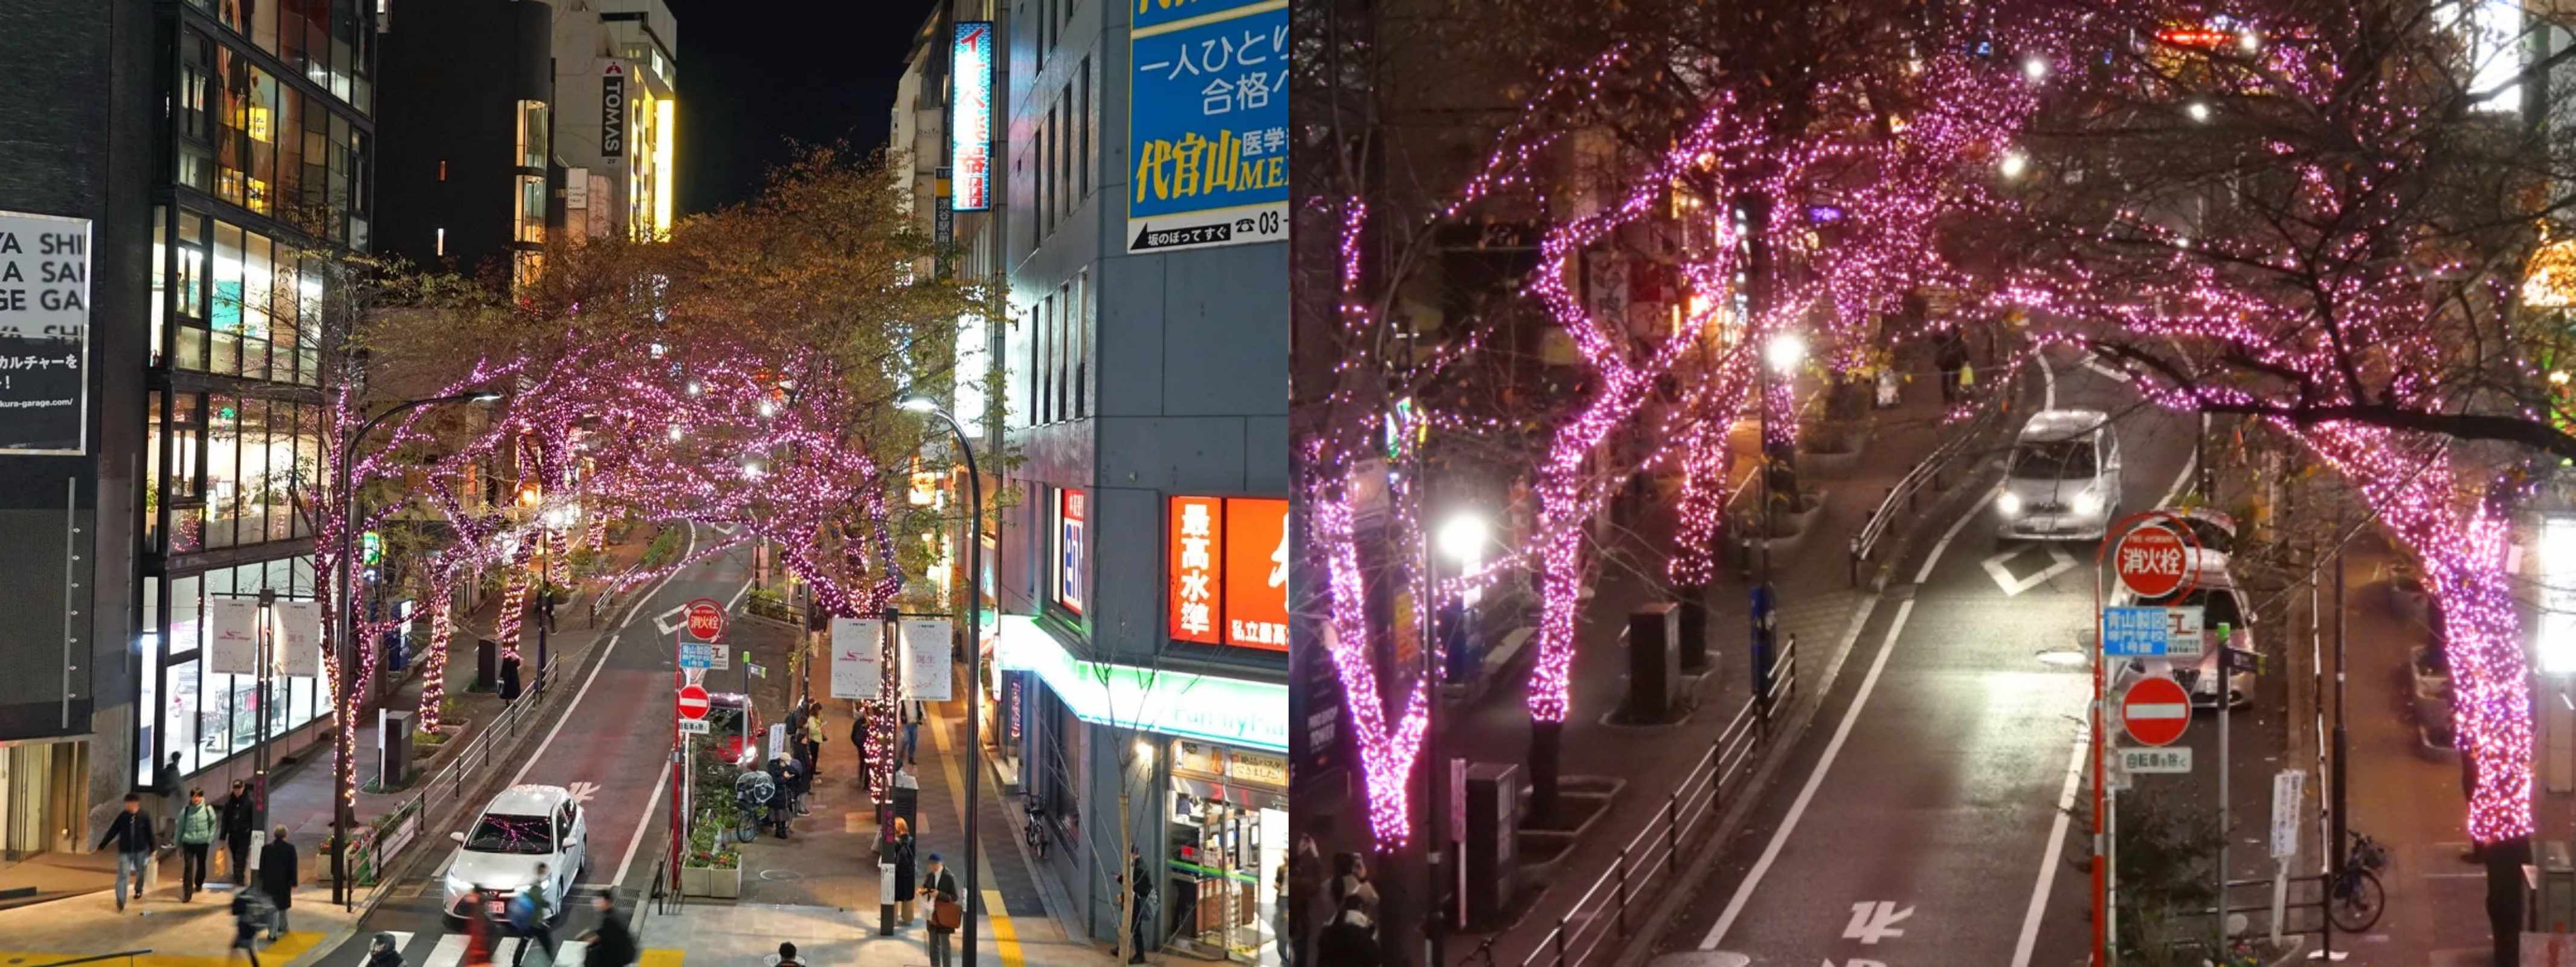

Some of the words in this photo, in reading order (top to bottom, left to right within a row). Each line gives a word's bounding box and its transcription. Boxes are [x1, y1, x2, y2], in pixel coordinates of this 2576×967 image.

[605, 82, 621, 151] TOMAS
[1243, 126, 1289, 157] 医学
[1136, 129, 1241, 203] 代官山
[1236, 155, 1289, 190] ME
[40, 233, 86, 255] SHI
[1148, 227, 1227, 247] 坂のぼってすぐ
[1180, 503, 1210, 635] 最高水準
[2124, 546, 2182, 575] 消火栓
[691, 615, 719, 629] 消火栓
